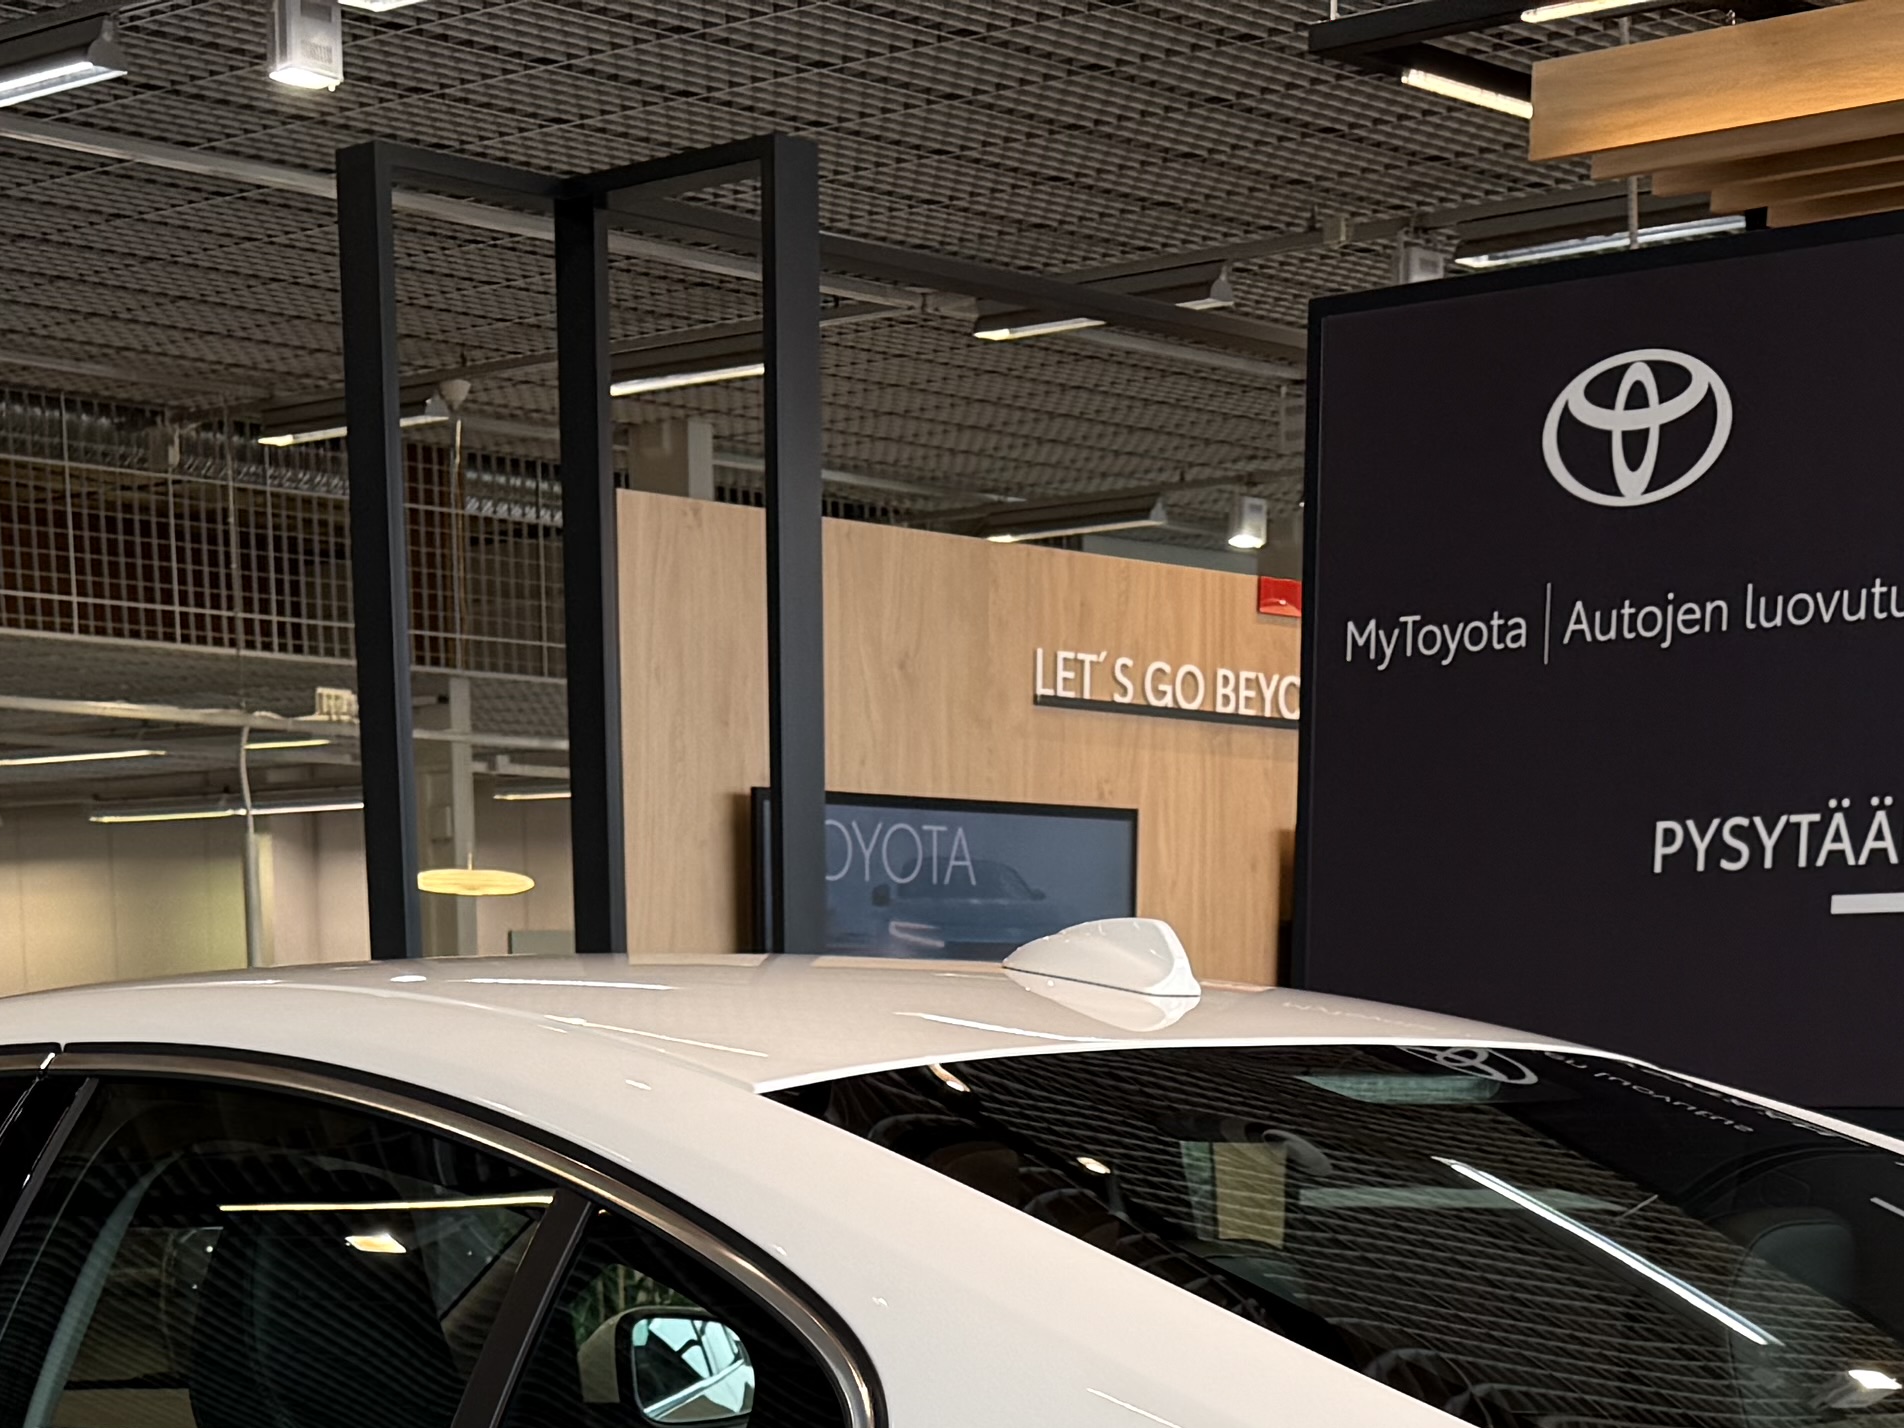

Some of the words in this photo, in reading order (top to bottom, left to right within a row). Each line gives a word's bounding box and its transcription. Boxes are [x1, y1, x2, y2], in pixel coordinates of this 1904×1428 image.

[1345, 609, 1528, 670] MyToyota
[1563, 590, 1729, 649] Autojen
[1144, 661, 1205, 710] GO
